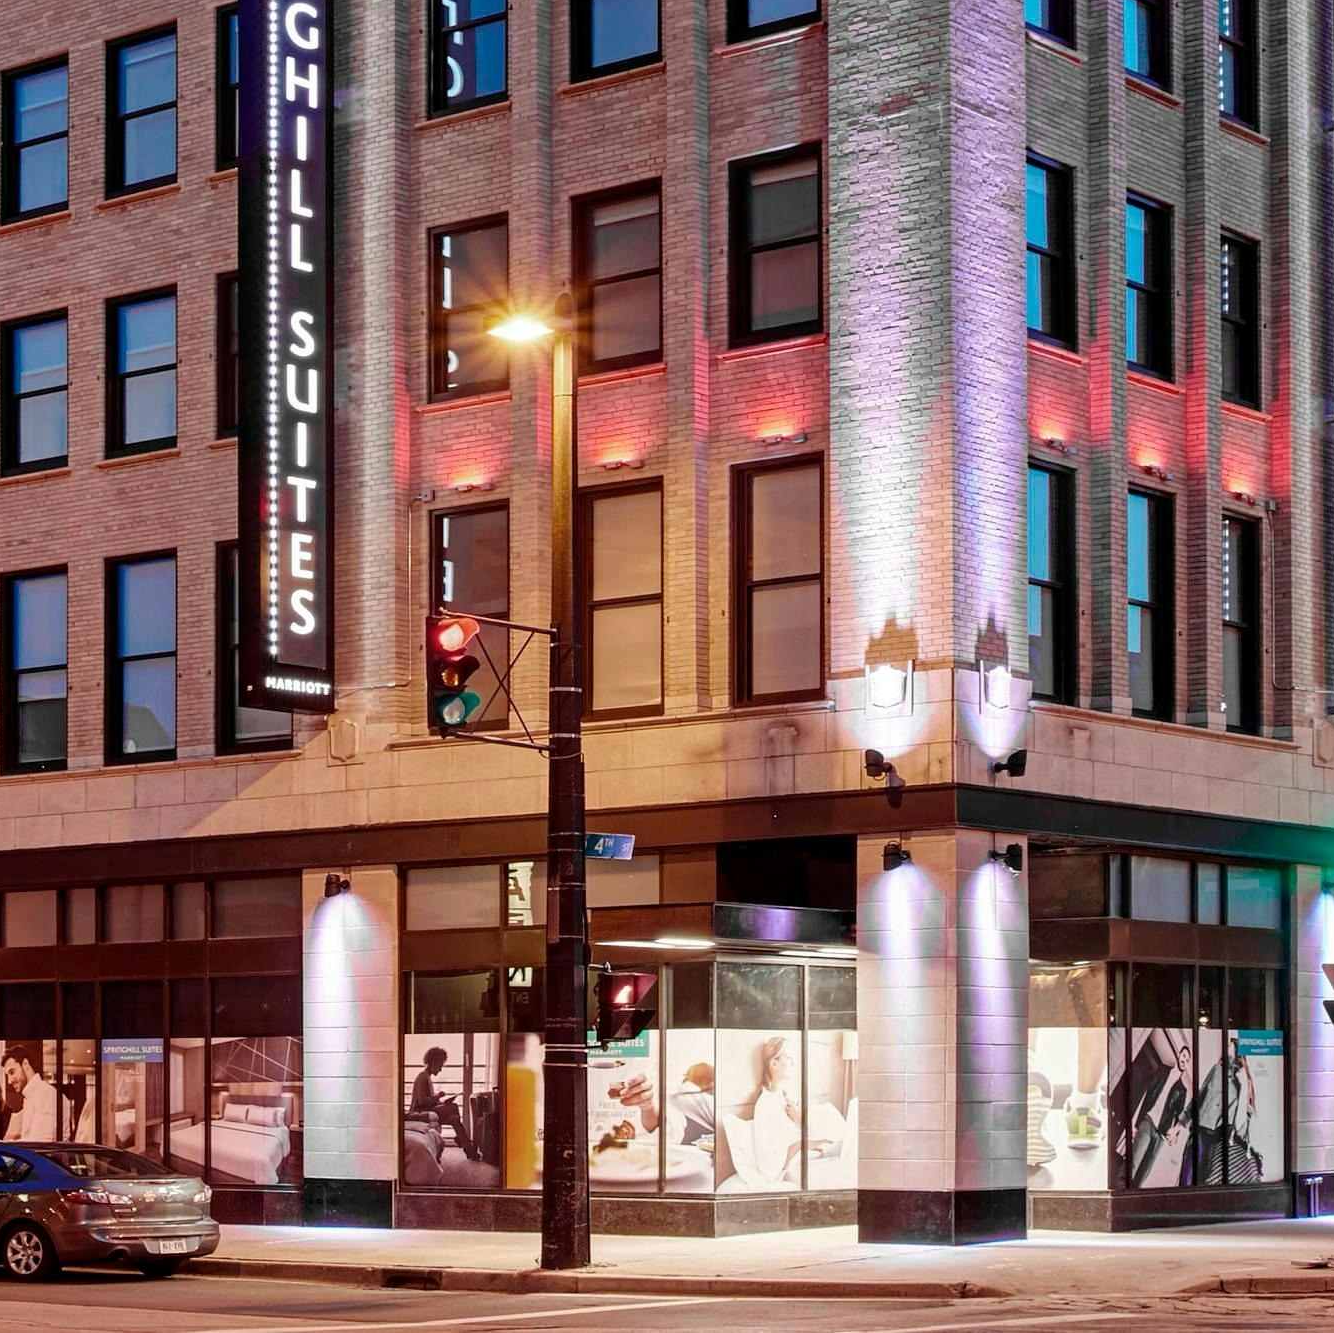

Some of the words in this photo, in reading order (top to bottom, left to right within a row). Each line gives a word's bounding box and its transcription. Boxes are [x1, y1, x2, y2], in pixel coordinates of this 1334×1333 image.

[286, 310, 318, 635] SUITES
[265, 676, 331, 696] MARRIOTT
[594, 837, 614, 854] 4TH
